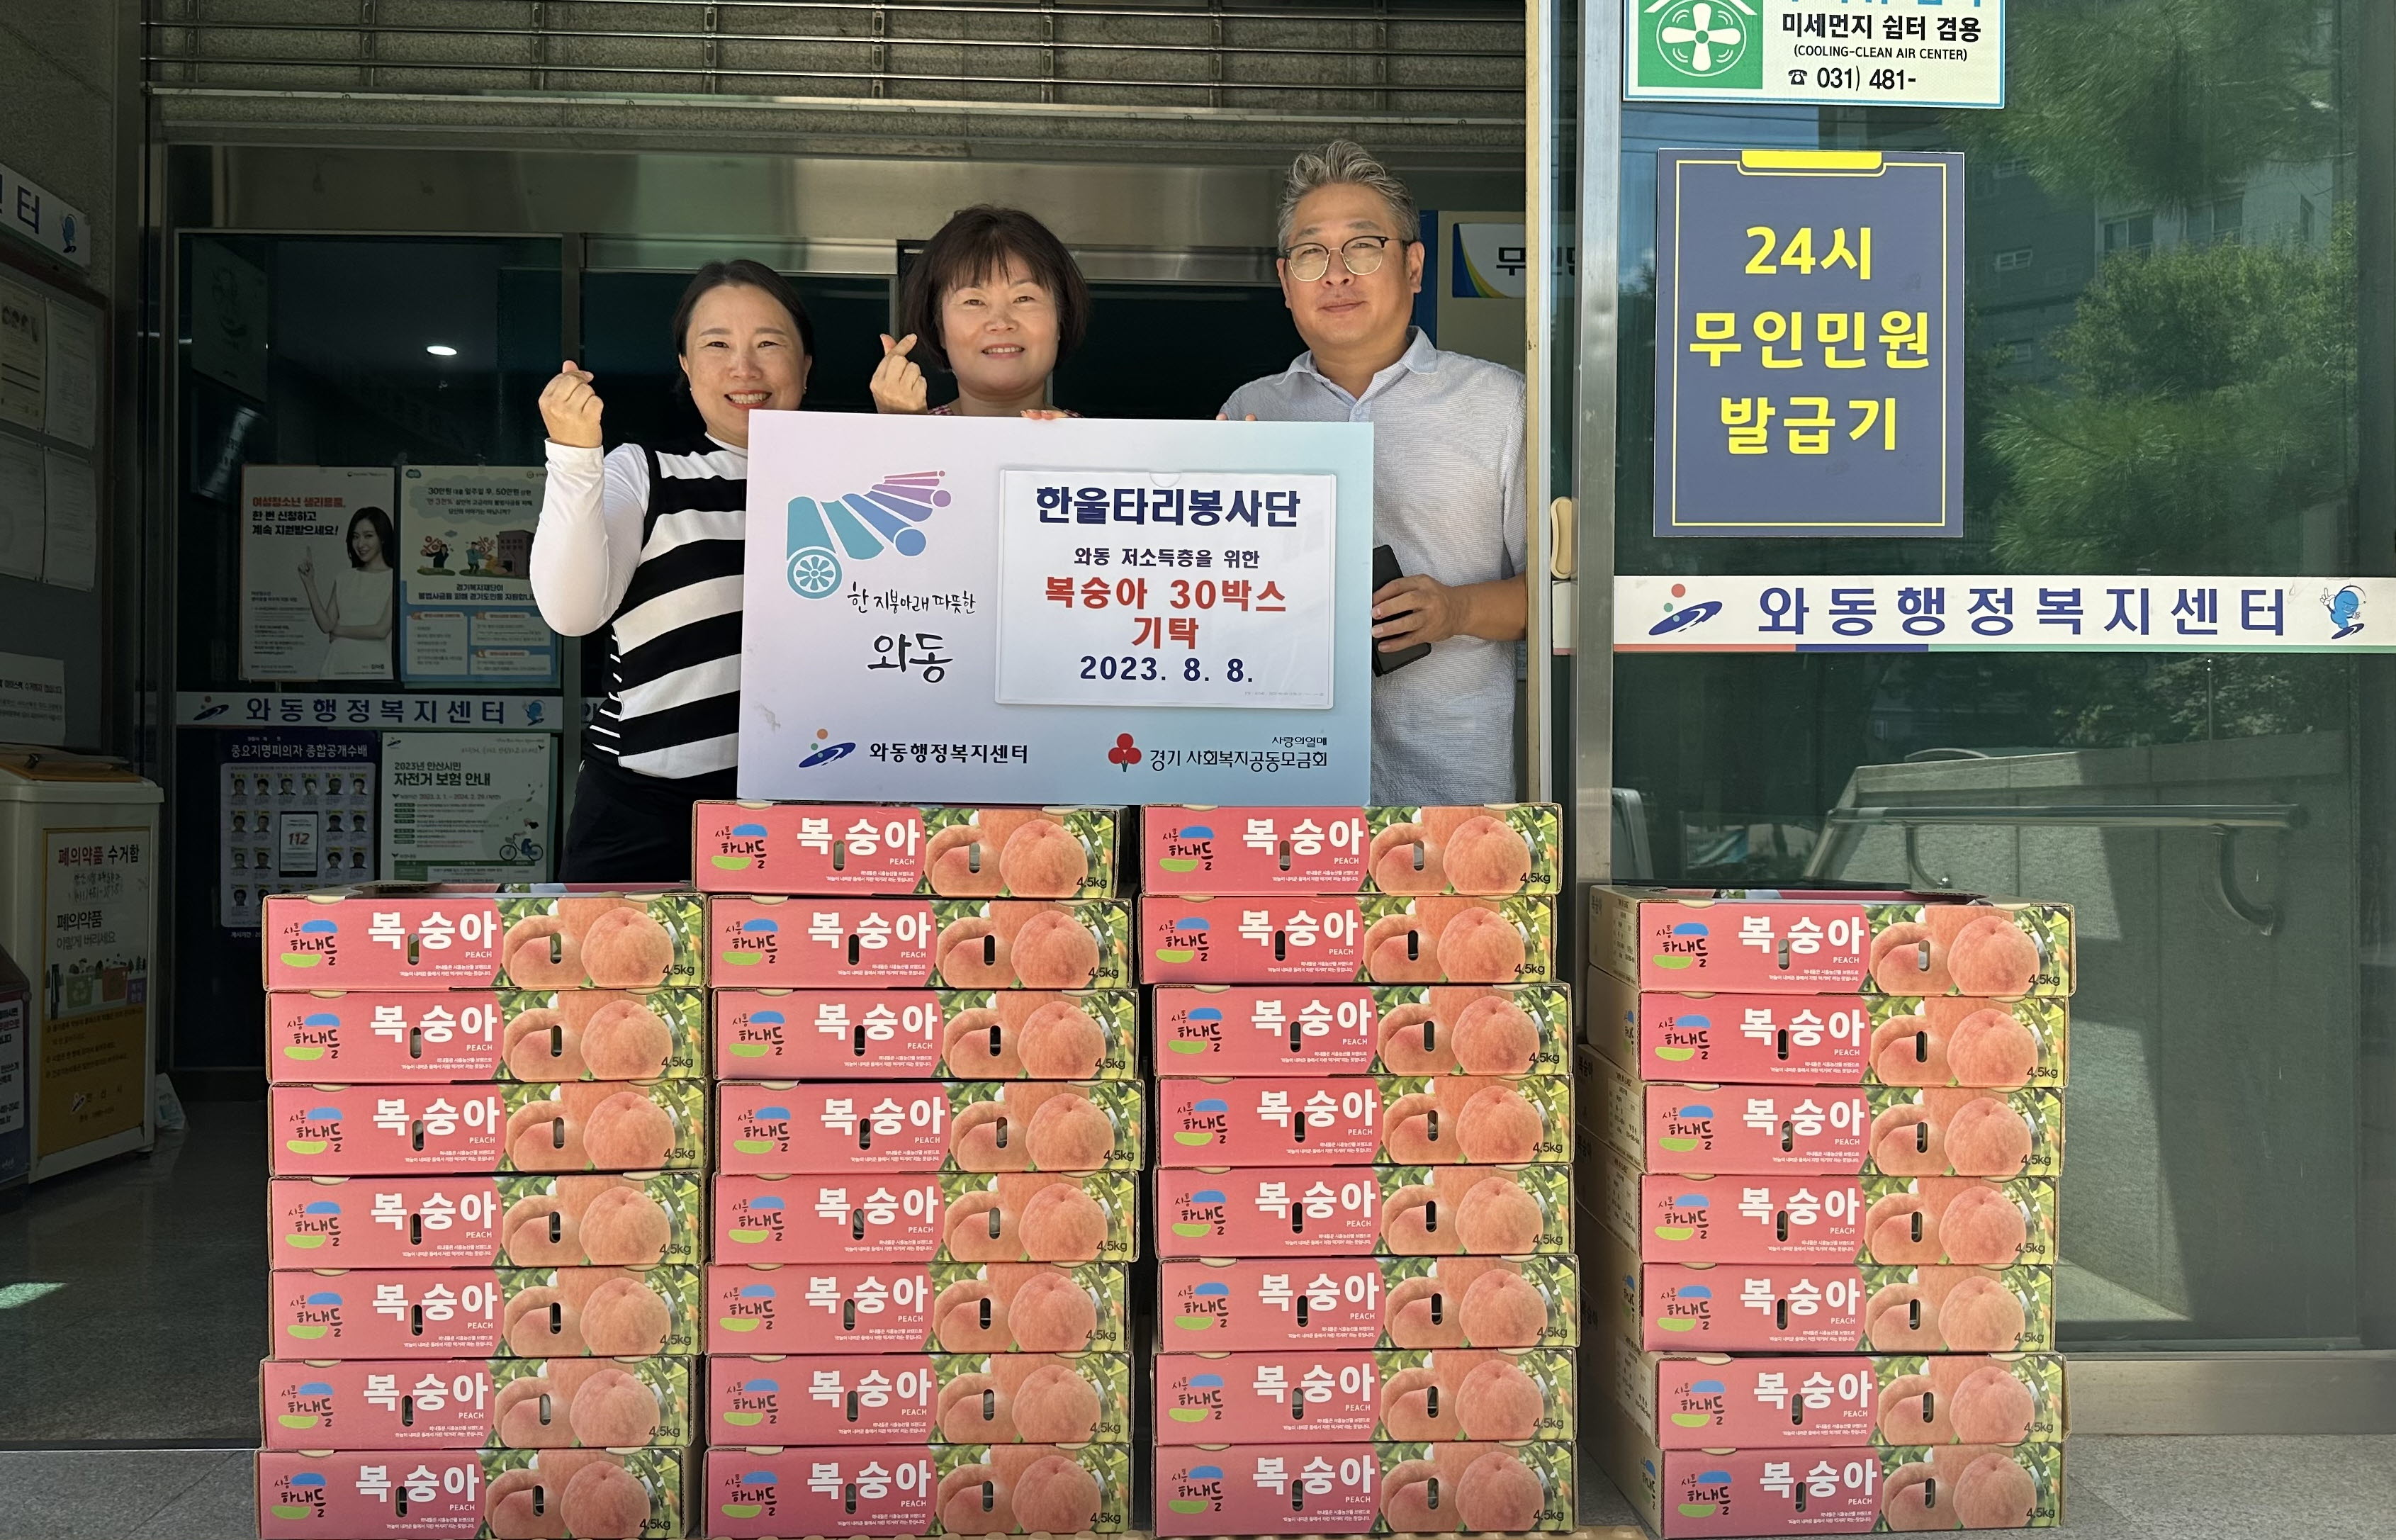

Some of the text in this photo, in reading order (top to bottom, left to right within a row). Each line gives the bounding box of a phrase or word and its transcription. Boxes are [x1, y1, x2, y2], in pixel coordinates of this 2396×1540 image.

[1782, 13, 1981, 43] 미세먼지 쉼터 겸용
[1794, 44, 1968, 62] (COOLING-CLEAN AIR CENTER)
[1816, 67, 1916, 91] 031) 481-
[1745, 227, 1872, 280] 24시
[1689, 310, 1929, 369] 무인민원
[1721, 397, 1897, 455] 발급기
[252, 511, 263, 522] 한
[1036, 486, 1300, 529] 한울타리봉사단
[1074, 547, 1261, 570] 와동 저소득층을 위한
[846, 581, 977, 614] 한 지붕아래 따뜻한
[1045, 576, 1287, 614] 복숭아 30박스
[1757, 586, 2285, 637] 와동행정복지센터
[1132, 615, 1199, 650] 기탁
[866, 632, 953, 684] 와동
[1080, 656, 1254, 684] 2023. 8. 8.
[245, 698, 505, 724] 와동행정복지센터
[231, 744, 368, 758] 중요지명피의자 종합공개수배
[870, 743, 1028, 765] 와동행정복지센터
[1149, 748, 1327, 772] 경기 사회복지공동모금회
[394, 772, 490, 786] 자전거 보험 안내
[289, 833, 310, 845] 112
[721, 839, 766, 870] 하내들
[797, 817, 921, 856] 복숭아
[1242, 818, 1364, 855] 복숭아
[58, 844, 140, 867] 폐의약품 수거함
[1076, 876, 1107, 889] 4.5kg
[57, 911, 103, 931] 폐의약품
[368, 911, 497, 950] 복숭아
[808, 911, 931, 949] 복숭아
[1238, 909, 1359, 947] 복숭아
[1738, 916, 1865, 955] 복숭아
[291, 935, 337, 966] 하내들
[1166, 932, 1209, 962] 하내들
[1663, 938, 1708, 968] 하내들
[663, 964, 694, 977] 4.5kg
[1515, 963, 1545, 977] 4.5kg
[2029, 974, 2060, 987] 4.5kg
[370, 1004, 497, 1043] 복숭아
[814, 1003, 938, 1040] 복숭아
[1251, 999, 1372, 1037] 복숭아
[1740, 1008, 1865, 1047] 복숭아
[373, 1096, 500, 1136] 복숭아
[821, 1096, 943, 1135] 복숭아
[1256, 1089, 1377, 1128] 복숭아
[1743, 1098, 1865, 1136] 복숭아
[371, 1191, 497, 1230] 복숭아
[814, 1186, 939, 1225] 복숭아
[1255, 1180, 1376, 1219] 복숭아
[1738, 1187, 1860, 1225] 복숭아
[739, 1211, 784, 1242] 하내들
[1665, 1209, 1709, 1240] 하내들
[1096, 1240, 1127, 1254] 4.5kg
[2015, 1242, 2045, 1256] 4.5kg
[372, 1282, 497, 1321] 복숭아
[805, 1275, 928, 1314] 복숭아
[1258, 1272, 1380, 1312] 복숭아
[1740, 1278, 1861, 1315] 복숭아
[297, 1308, 342, 1338] 하내들
[1184, 1298, 1228, 1328] 하내들
[660, 1334, 691, 1347] 4.5kg
[1537, 1326, 1567, 1339] 4.5kg
[364, 1372, 489, 1411] 복숭아
[809, 1368, 932, 1407] 복숭아
[1253, 1363, 1375, 1403] 복숭아
[1753, 1370, 1873, 1410] 복숭아
[356, 1463, 480, 1502] 복숭아
[807, 1460, 931, 1499] 복숭아
[1253, 1455, 1375, 1495] 복숭아
[1760, 1458, 1877, 1497] 복숭아
[732, 1486, 777, 1517] 하내들
[1090, 1512, 1120, 1525] 4.5kg
[1688, 1485, 1731, 1516] 하내들
[2026, 1507, 2055, 1520] 4.5kg
